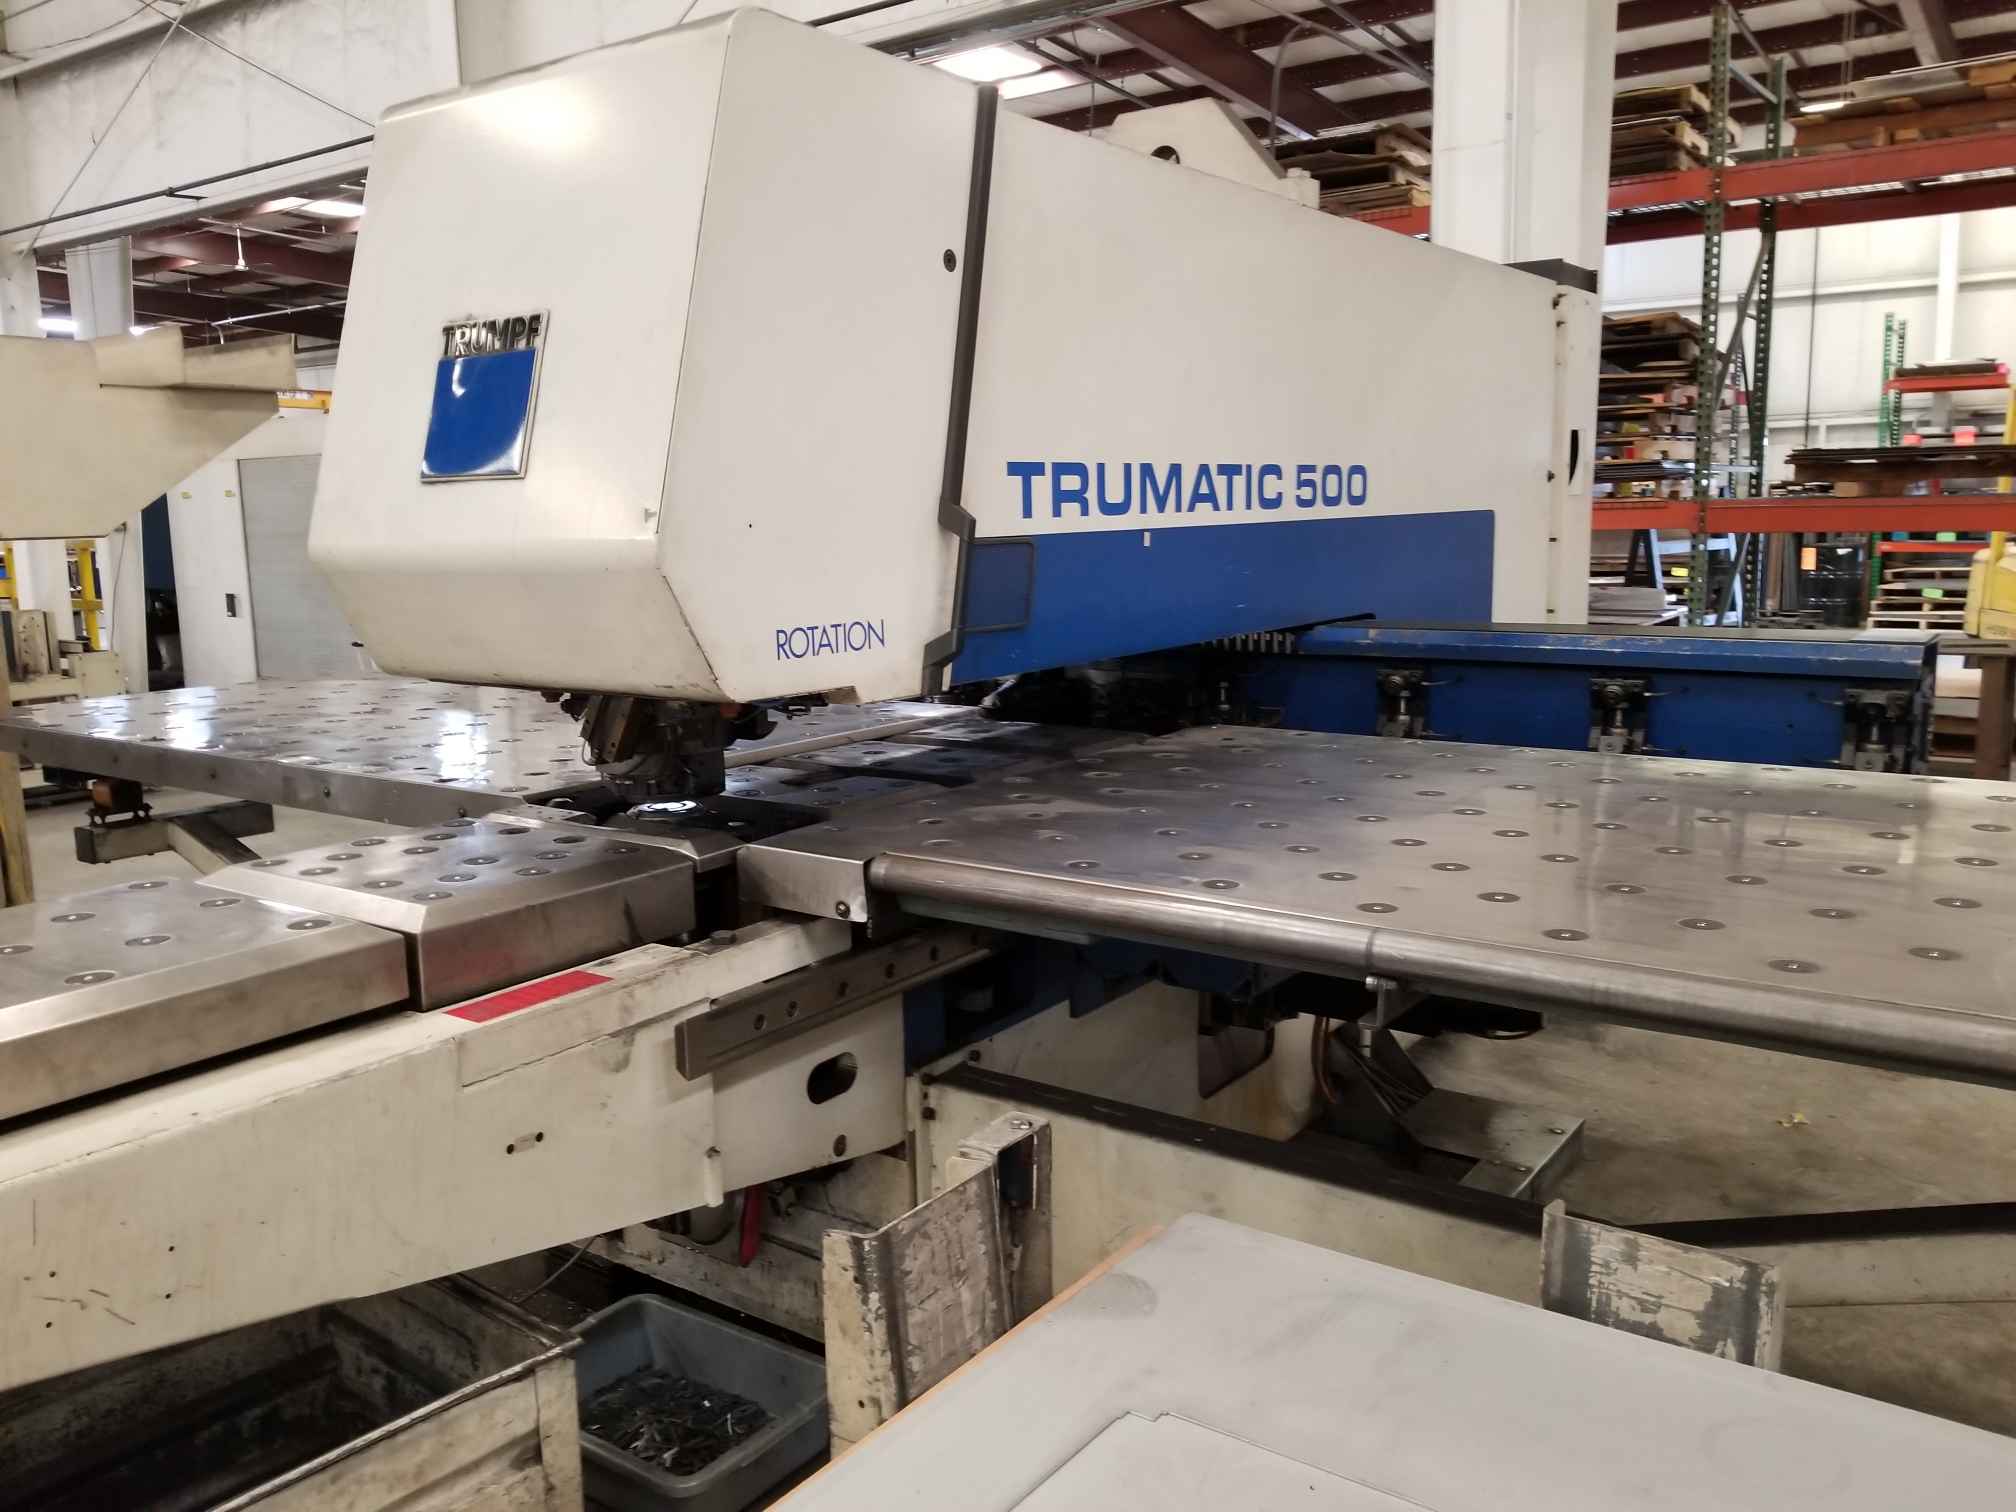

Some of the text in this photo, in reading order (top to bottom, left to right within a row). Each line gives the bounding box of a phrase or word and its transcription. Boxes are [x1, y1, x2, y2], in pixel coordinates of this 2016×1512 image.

[442, 313, 542, 356] TRUMPF
[1006, 461, 1368, 518] TRUMATIC 500
[776, 619, 885, 660] ROTATION
